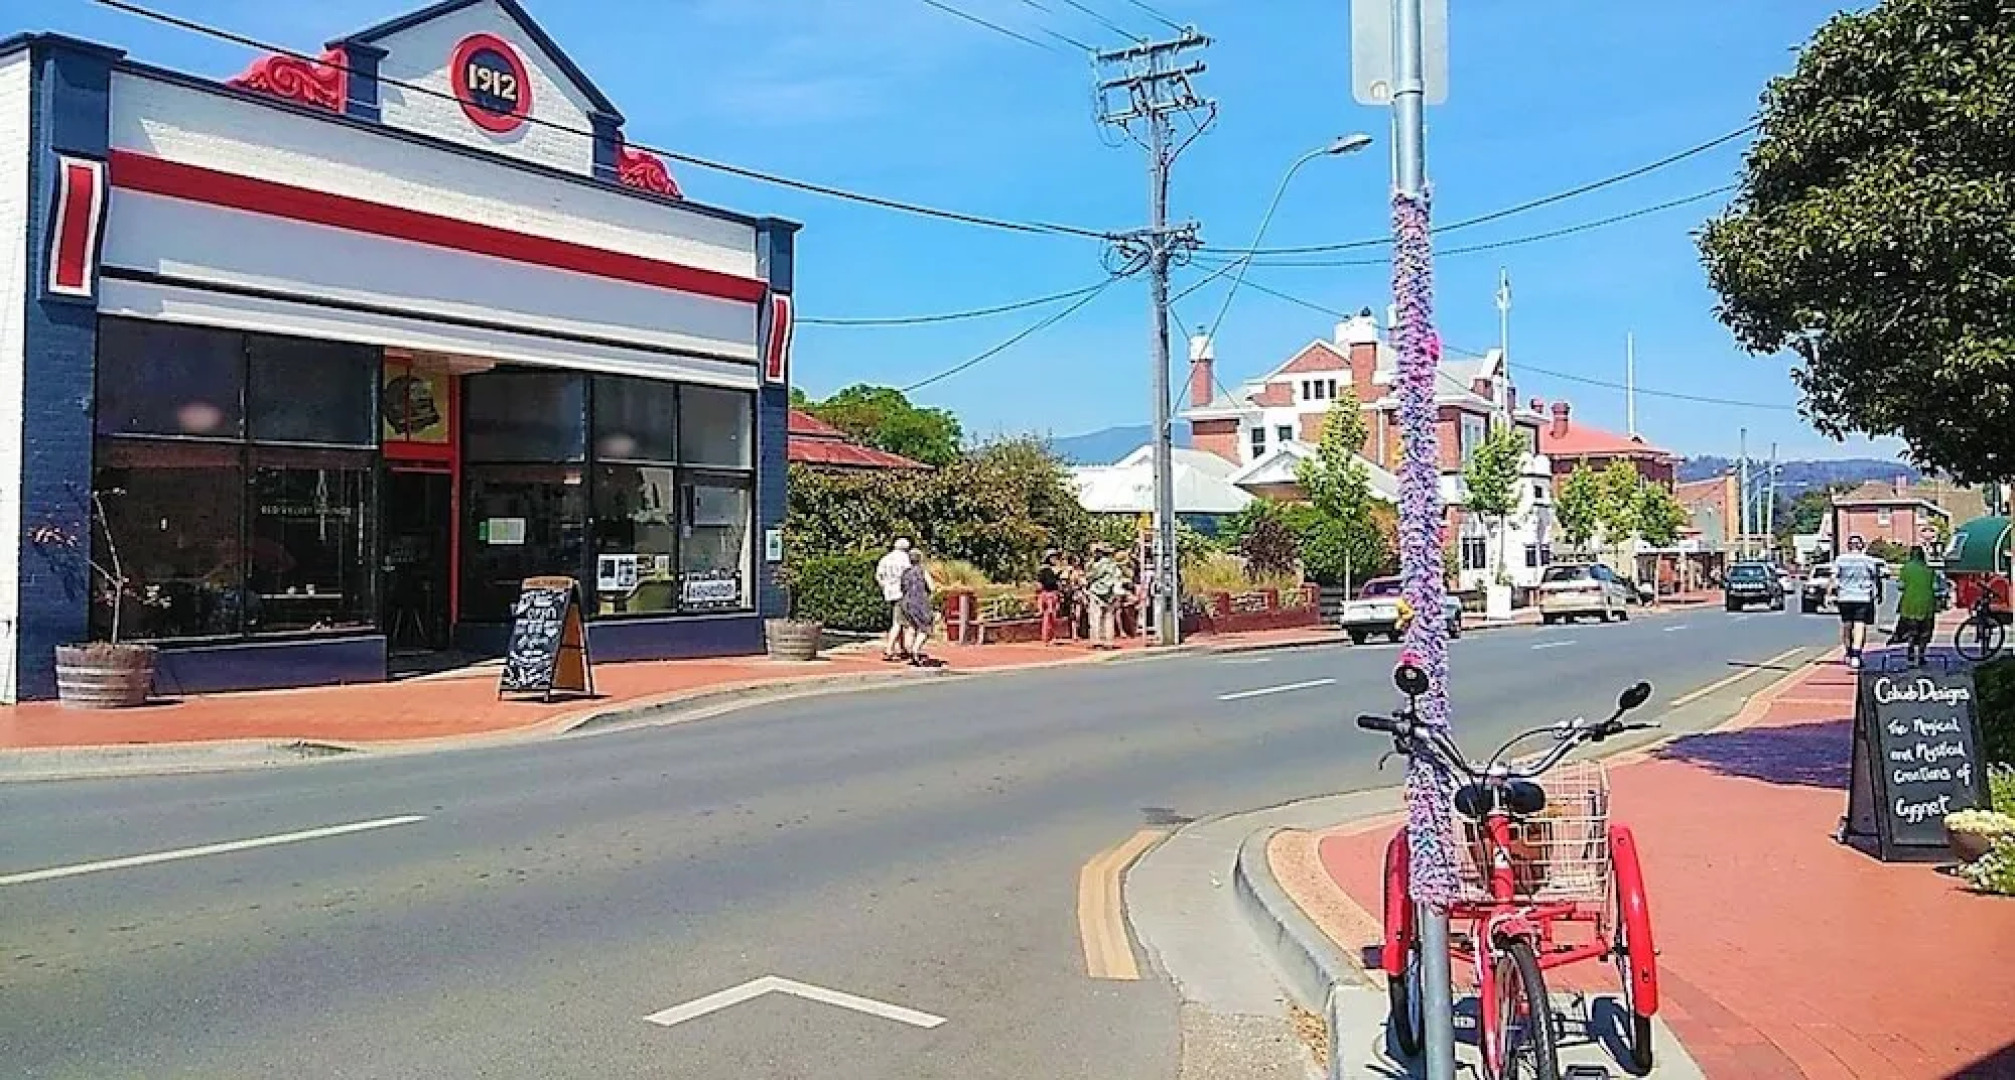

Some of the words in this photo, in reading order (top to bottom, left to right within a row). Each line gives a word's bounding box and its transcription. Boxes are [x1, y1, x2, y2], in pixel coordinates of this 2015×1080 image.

[468, 63, 517, 101] 1912
[1890, 748, 1915, 762] and
[1915, 740, 1966, 762] Mystical
[1893, 766, 1952, 785] Creations
[1956, 762, 1972, 787] of
[1895, 794, 1952, 823] Cygnet
